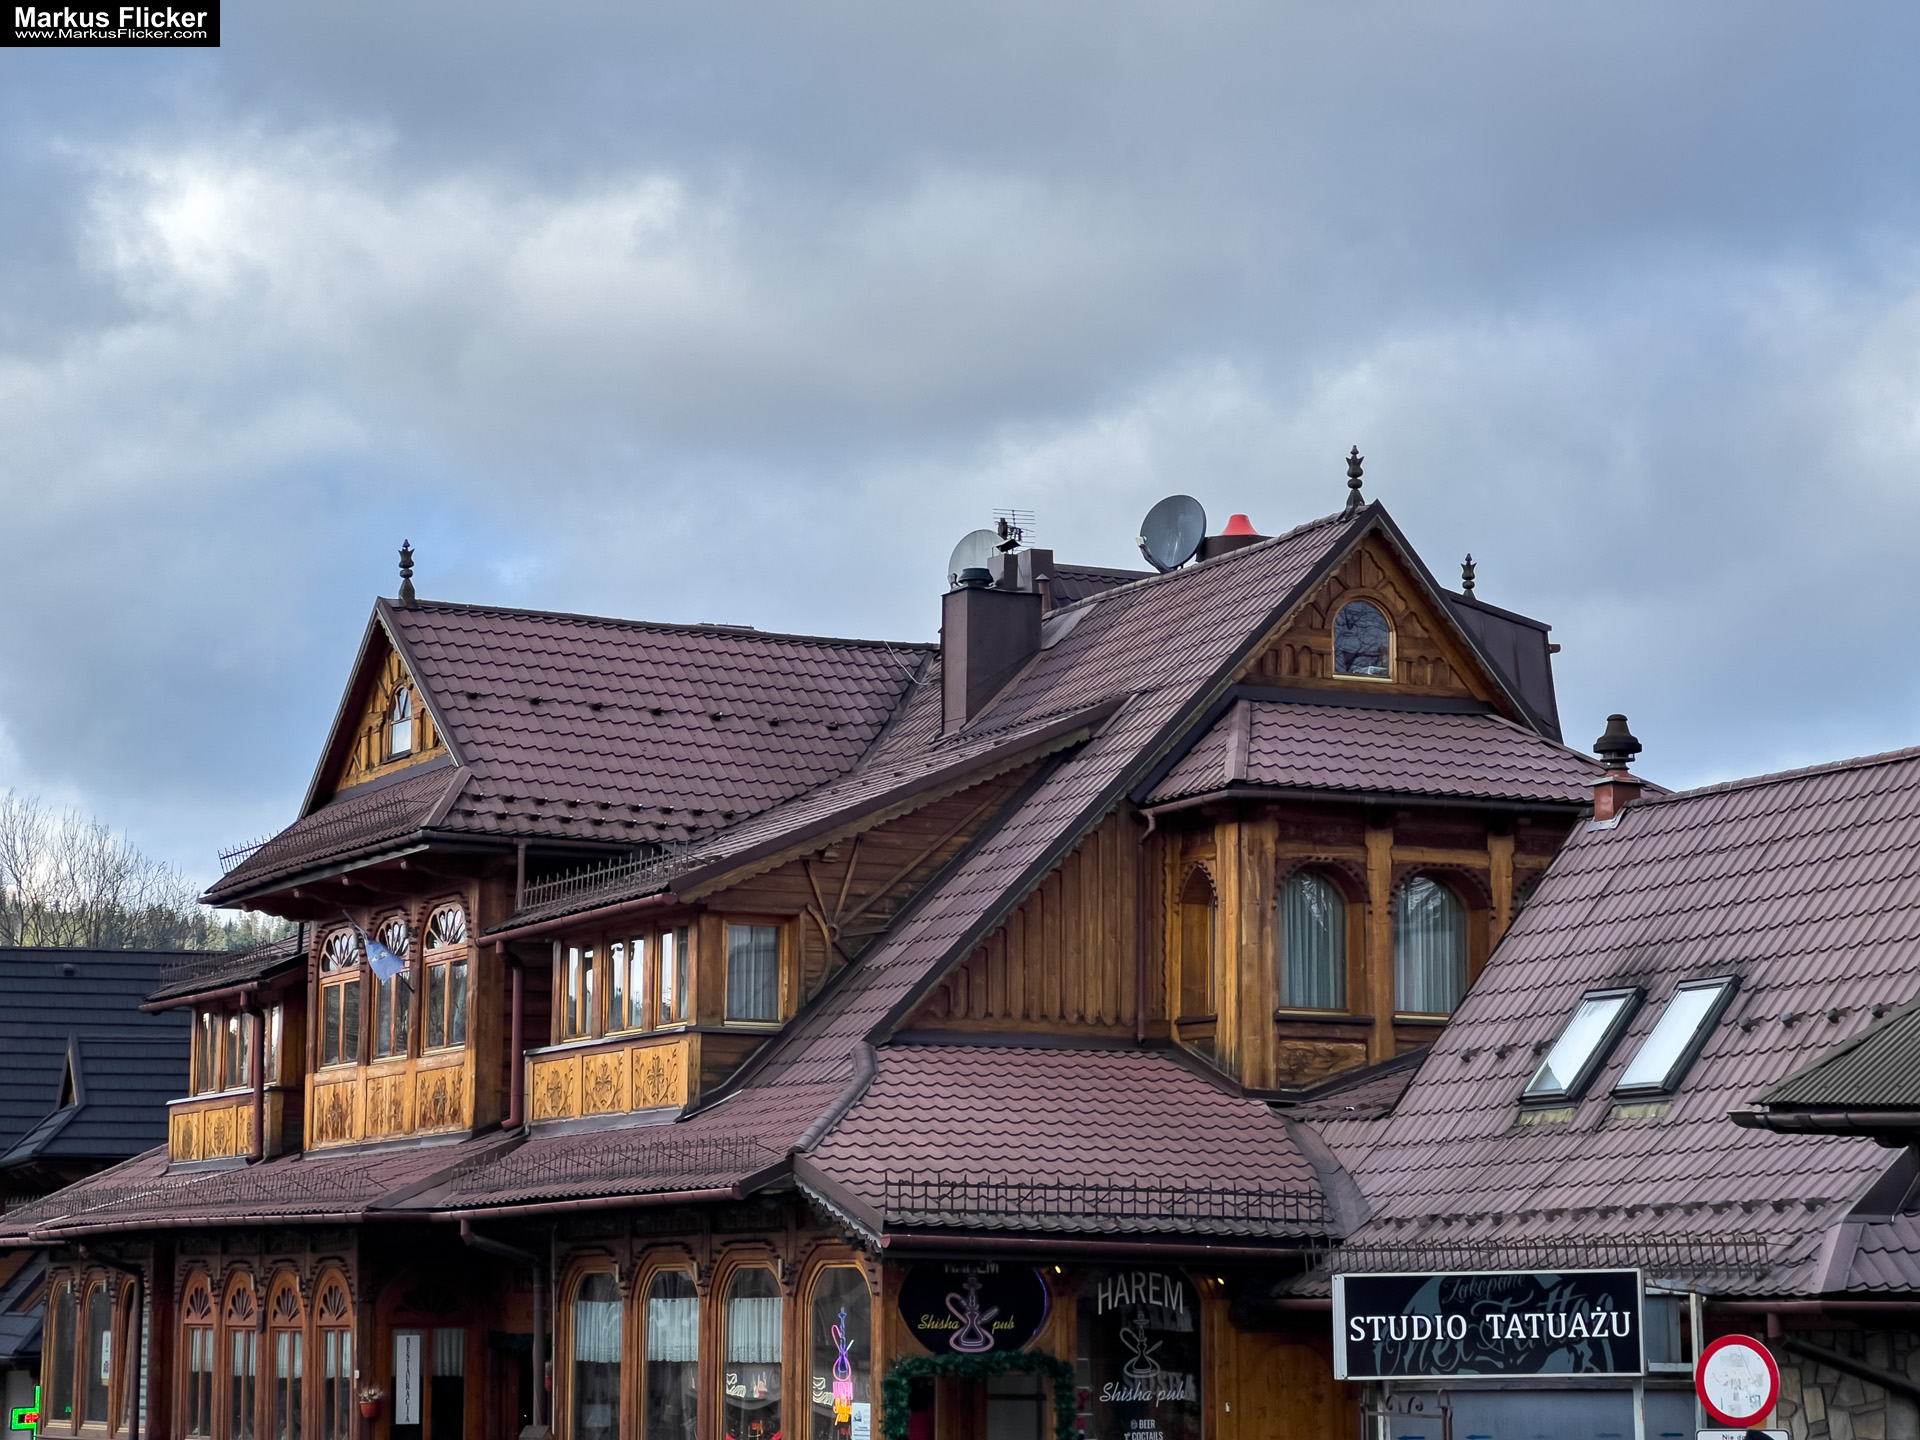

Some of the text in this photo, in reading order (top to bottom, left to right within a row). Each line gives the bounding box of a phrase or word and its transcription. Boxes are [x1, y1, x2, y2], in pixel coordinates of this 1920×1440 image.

[1097, 1271, 1184, 1316] HAREM
[917, 1314, 1016, 1335] Shisha pub
[1350, 1306, 1632, 1342] STUDIO TATUAŻU
[1099, 1381, 1187, 1408] Shisha pub
[1131, 1431, 1164, 1440] COCTAILS
[1138, 1419, 1156, 1429] BEER
